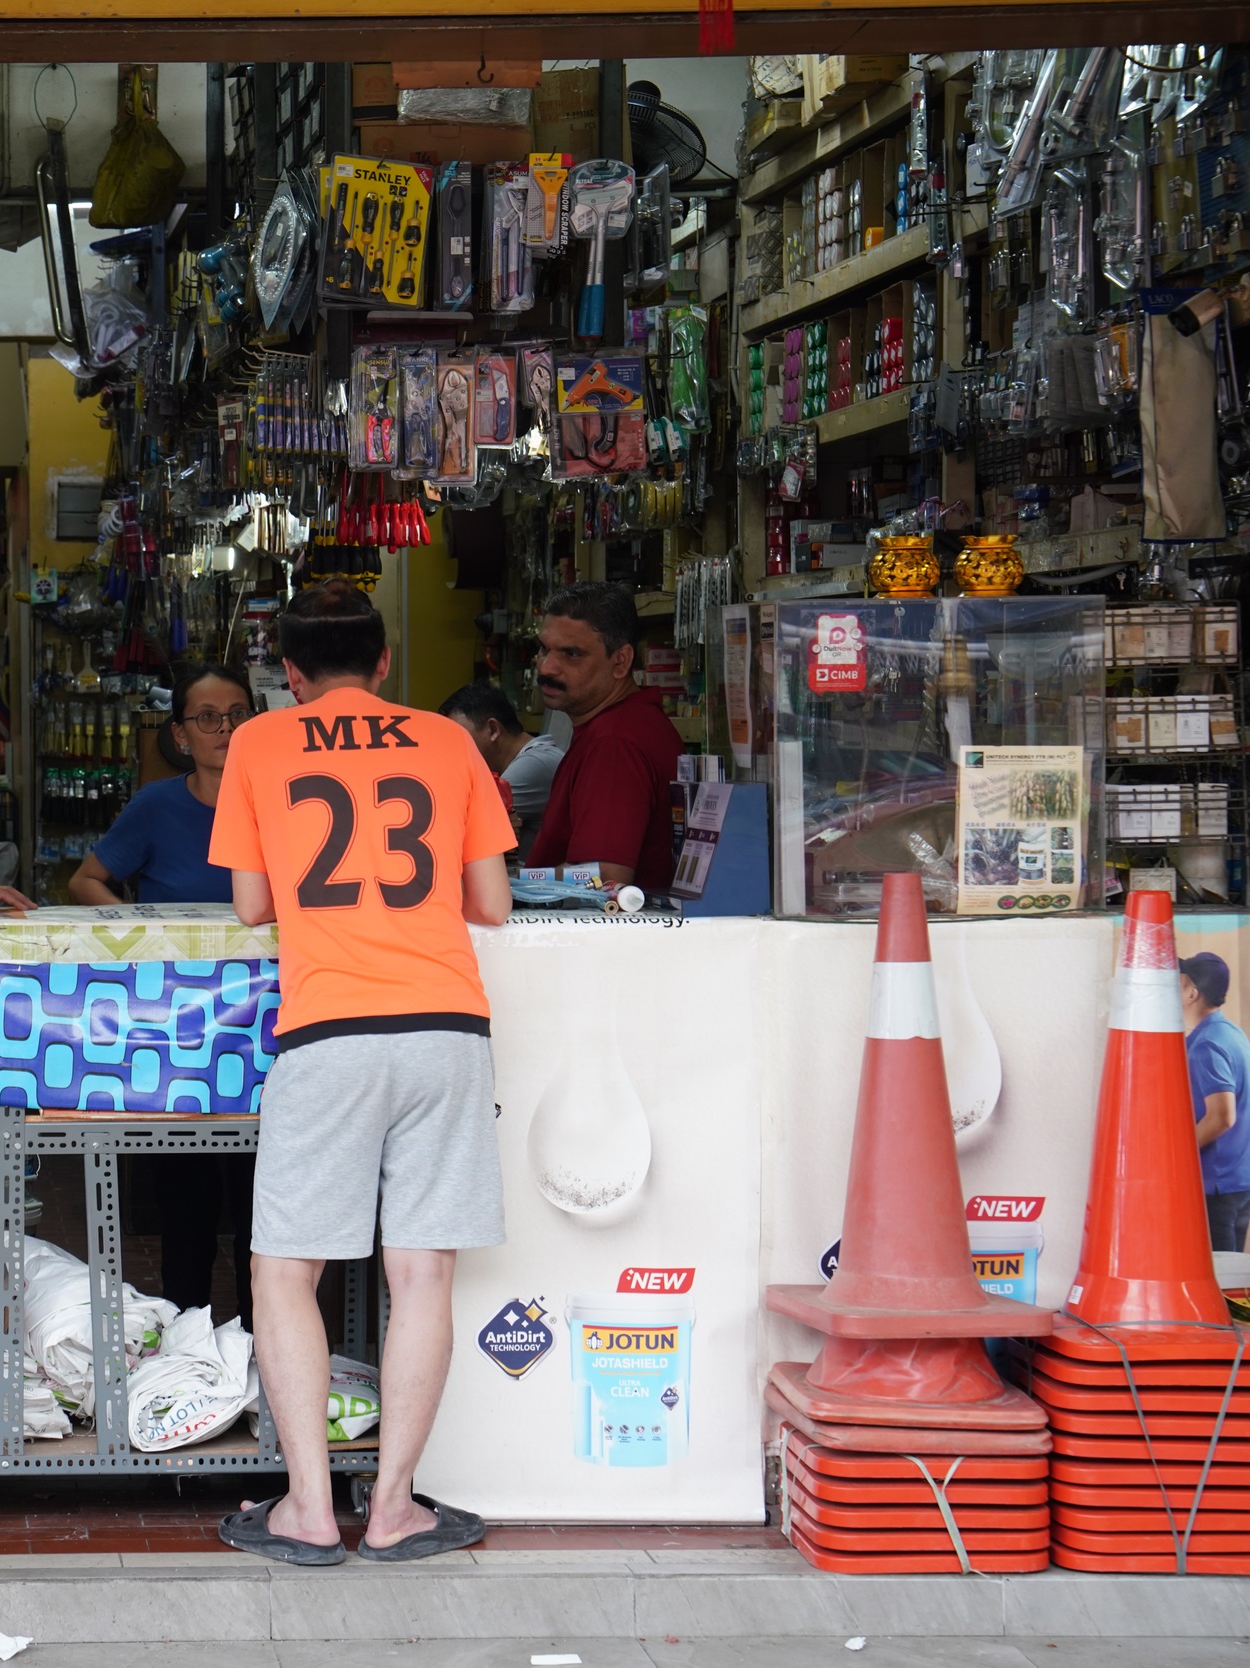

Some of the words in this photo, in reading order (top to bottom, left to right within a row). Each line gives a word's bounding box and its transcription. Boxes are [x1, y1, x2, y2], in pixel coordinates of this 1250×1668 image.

[354, 168, 411, 186] STANLEY
[561, 180, 570, 211] WINDOW
[561, 212, 569, 245] SCRAPER
[830, 670, 858, 680] CIMB
[298, 715, 419, 752] MK
[285, 771, 437, 912] 23
[977, 1200, 1036, 1218] NEW
[631, 1272, 687, 1290] NEW
[485, 1331, 545, 1343] AntiDirt
[606, 1333, 674, 1350] JOTUN
[490, 1344, 541, 1352] TECHNOLOGY
[592, 1357, 668, 1368] JOTASHIELD
[610, 1387, 650, 1398] CLEAN
